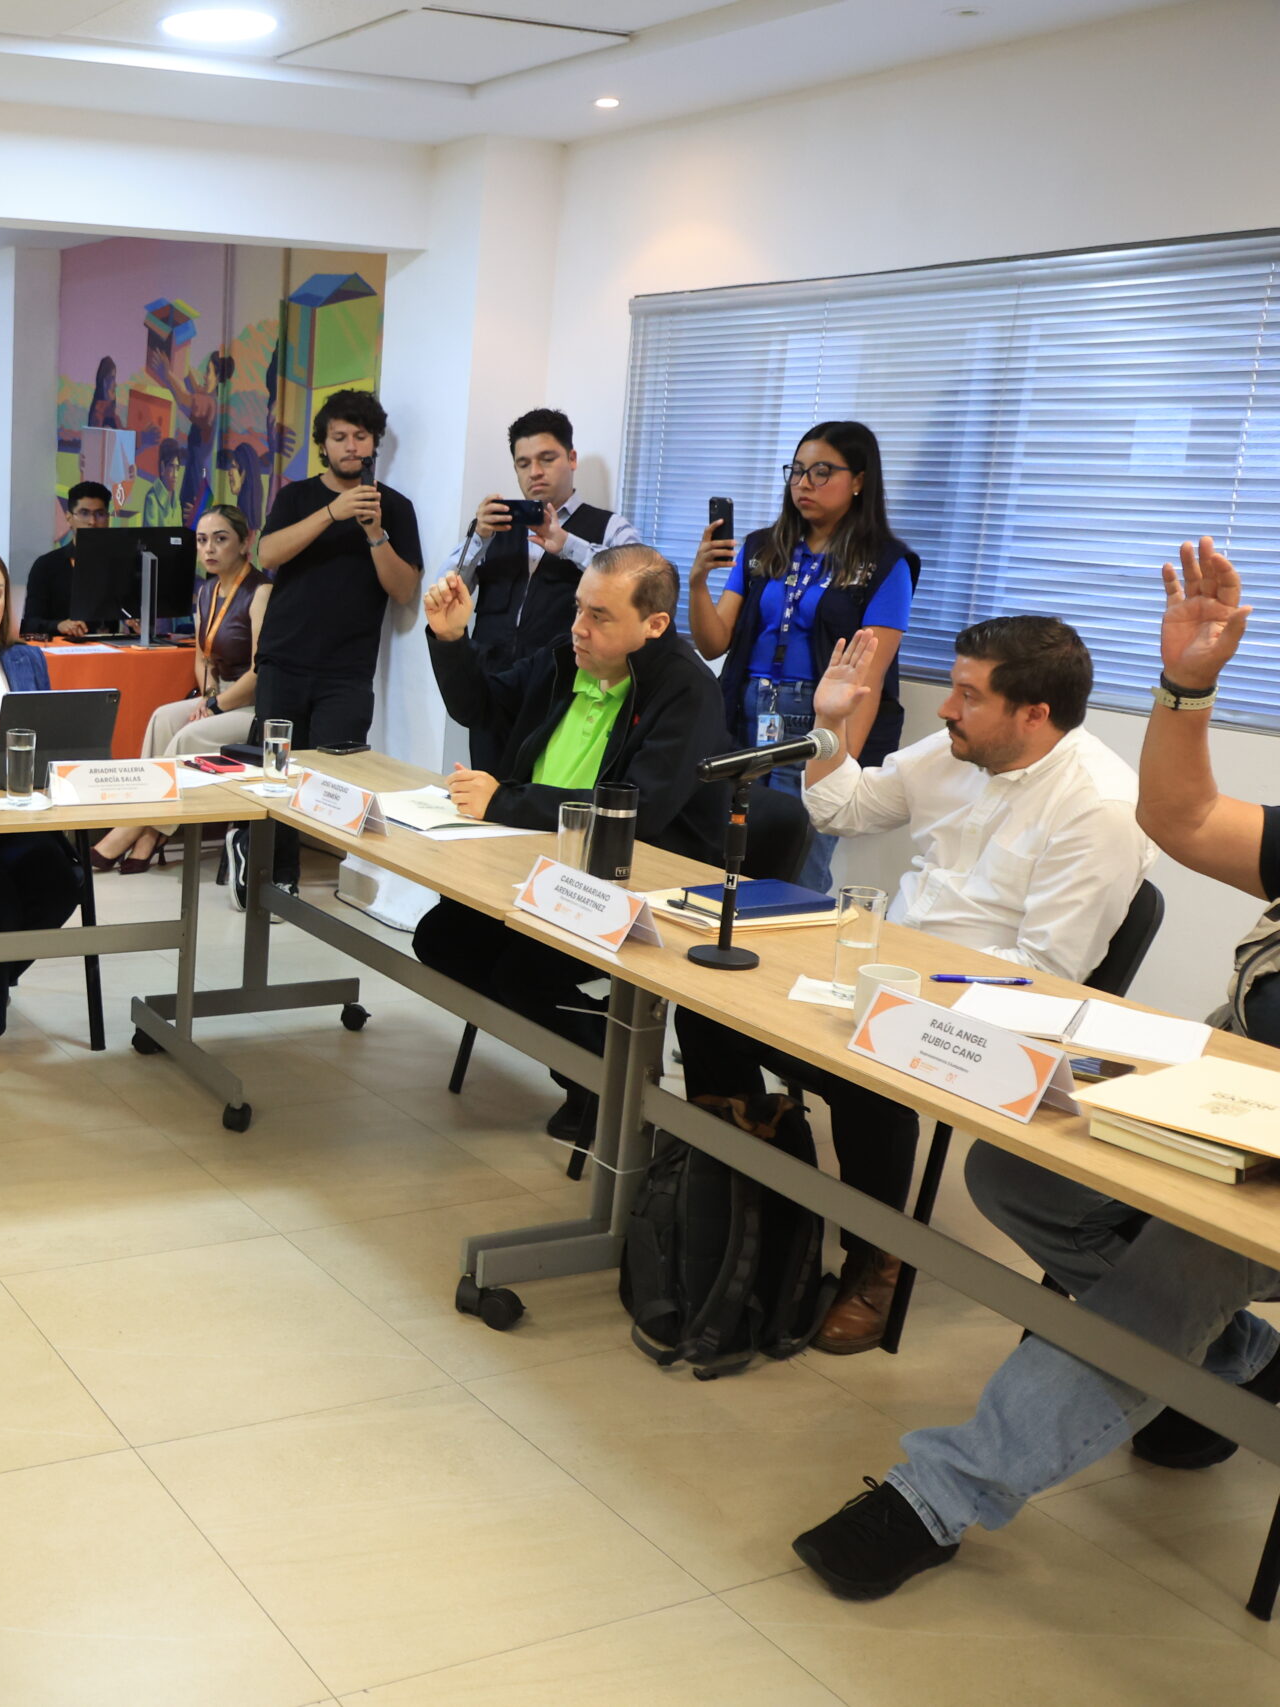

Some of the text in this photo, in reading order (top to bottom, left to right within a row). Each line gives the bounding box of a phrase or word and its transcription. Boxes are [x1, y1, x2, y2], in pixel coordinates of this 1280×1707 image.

[120, 775, 141, 783] SALAS
[560, 875, 611, 902] CARLOS MARIANO
[726, 874, 735, 886] H
[554, 884, 577, 899] ARENAS
[930, 1018, 988, 1049] RAÚL ANGEL
[921, 1032, 951, 1050] RUBIO
[951, 1045, 982, 1063] CANO
